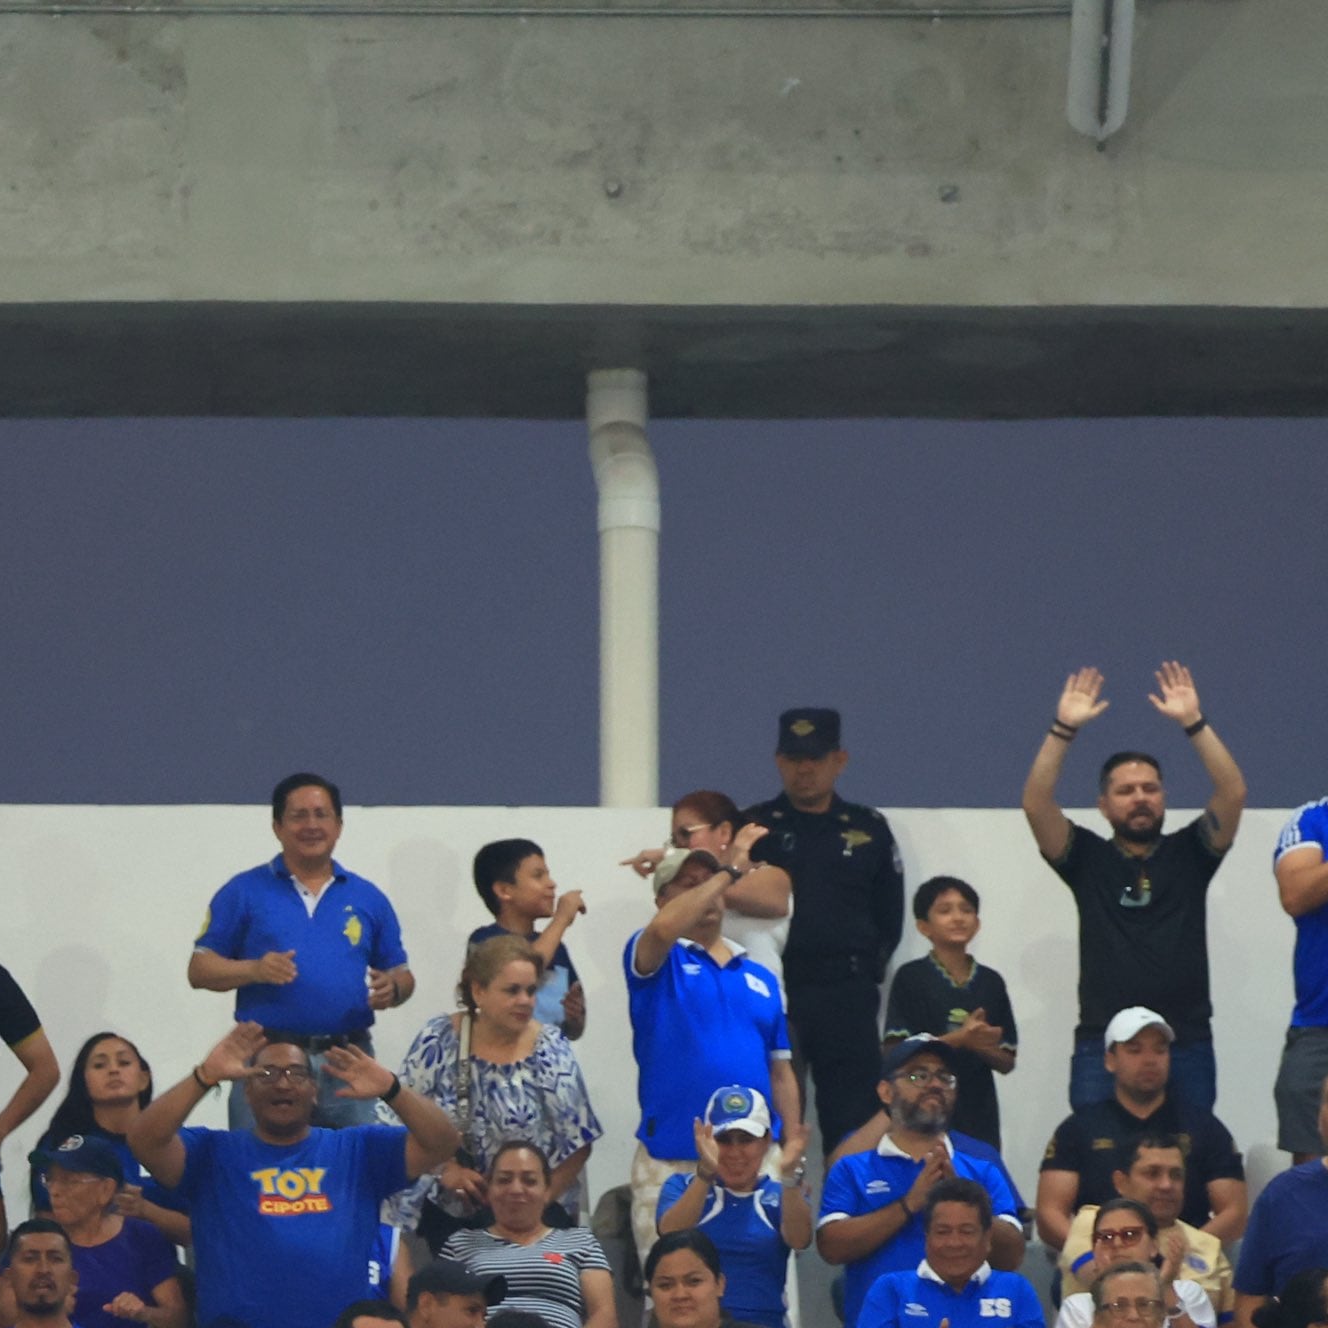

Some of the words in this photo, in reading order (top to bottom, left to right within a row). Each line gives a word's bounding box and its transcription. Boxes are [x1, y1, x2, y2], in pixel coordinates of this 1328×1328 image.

[251, 1167, 326, 1200] TOY
[261, 1199, 329, 1214] CIPOTE
[978, 1297, 1011, 1318] ES
